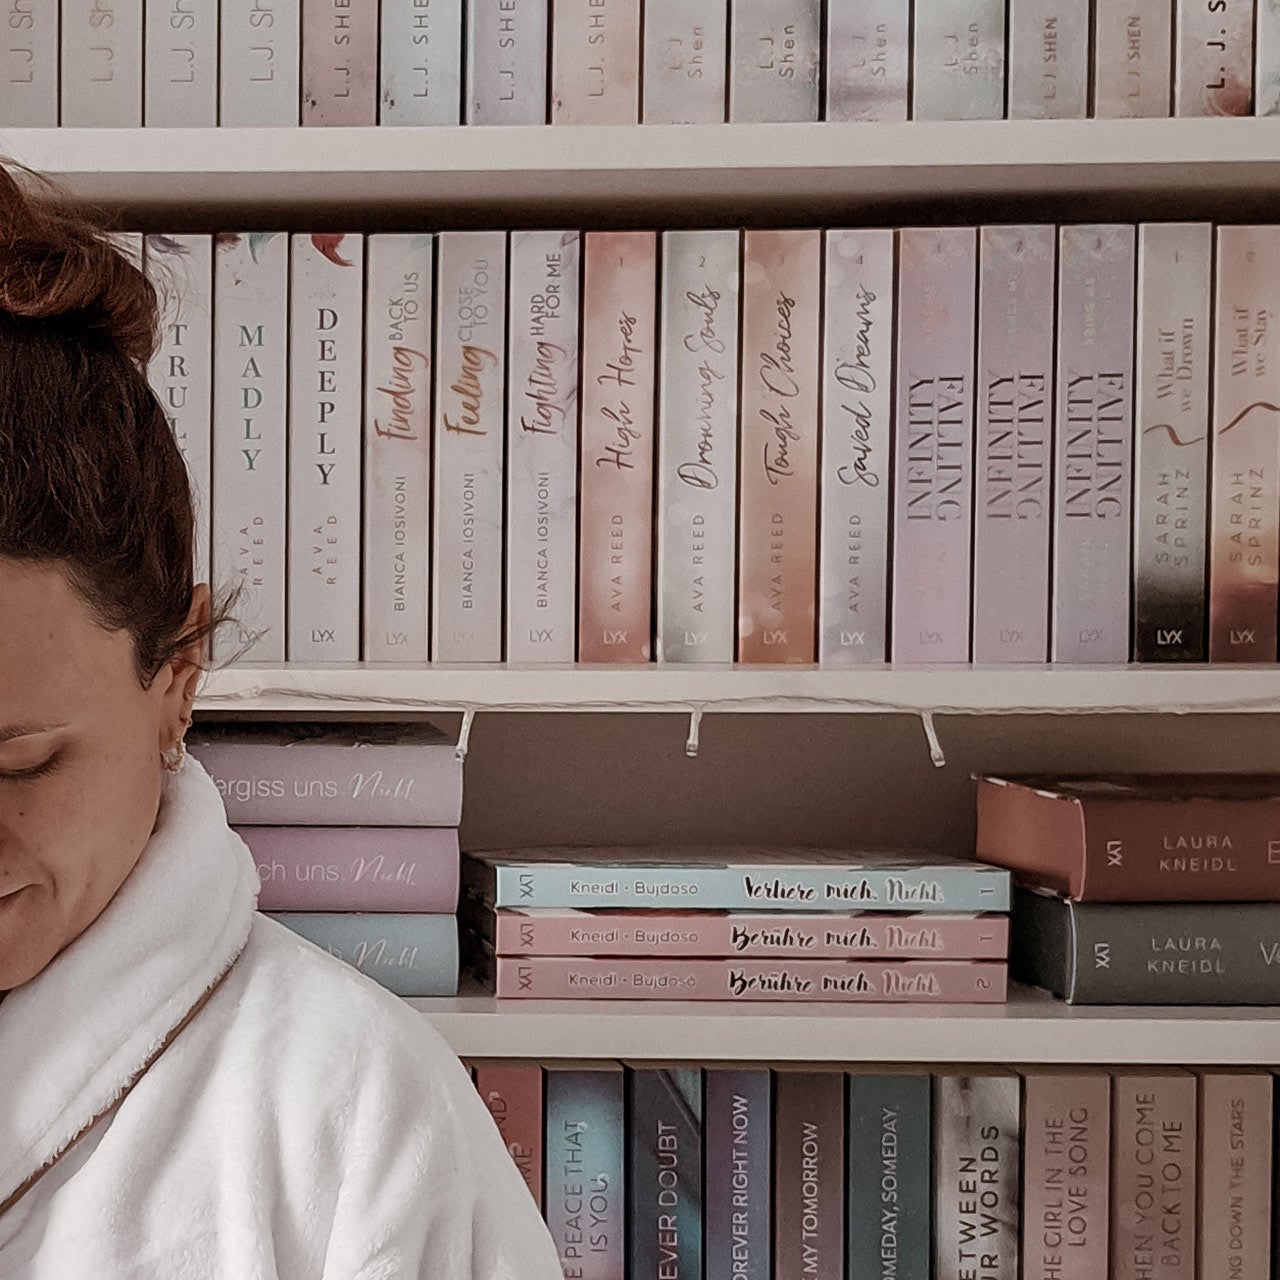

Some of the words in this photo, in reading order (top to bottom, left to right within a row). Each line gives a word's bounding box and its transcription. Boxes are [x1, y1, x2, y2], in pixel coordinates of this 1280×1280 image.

[779, 25, 795, 78] Shen
[404, 272, 418, 293] US
[547, 253, 561, 278] ME
[389, 297, 403, 341] BACK
[405, 301, 418, 323] TO
[530, 294, 545, 337] HARD
[546, 284, 560, 319] FOR
[374, 346, 429, 441] Finding
[521, 341, 565, 434] Fighting
[595, 400, 641, 470] High
[759, 405, 801, 486] Tough
[907, 372, 934, 520] INFINITY
[294, 779, 338, 797] uns
[1160, 858, 1237, 872] KNEIDL
[1163, 836, 1233, 849] LAURA
[732, 1095, 748, 1144] NOW
[1069, 1107, 1088, 1177] SONG
[658, 1120, 677, 1207] DOUBT
[732, 1149, 748, 1207] RIGHT
[803, 1122, 818, 1239] TOMORROW
[980, 1125, 999, 1236] WORDS
[1068, 1186, 1087, 1248] LOVE
[803, 1245, 818, 1273] MY
